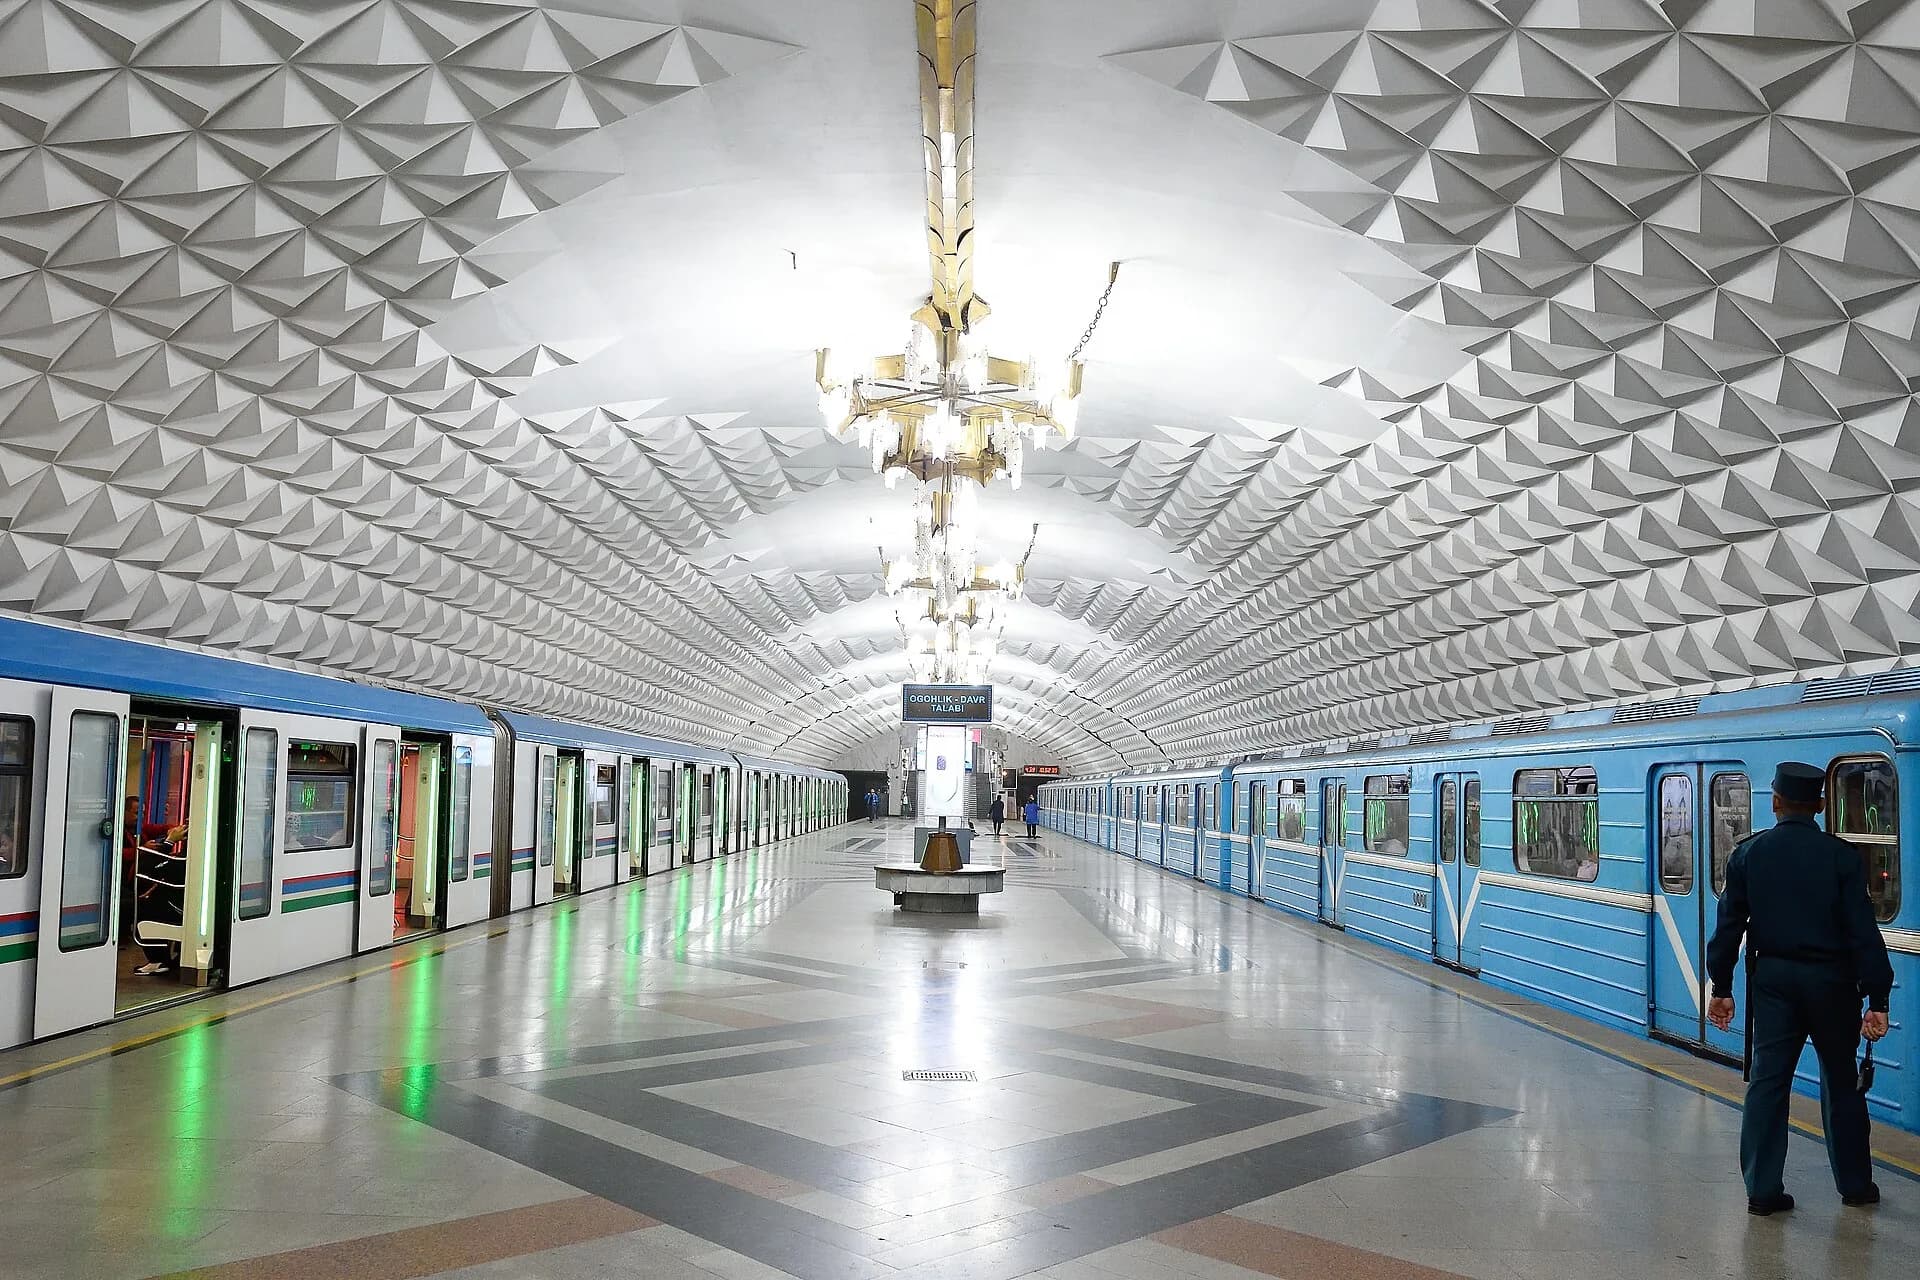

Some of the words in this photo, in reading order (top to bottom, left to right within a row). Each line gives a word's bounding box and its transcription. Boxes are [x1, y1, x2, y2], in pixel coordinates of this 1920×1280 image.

[909, 695, 953, 703] OGOHLIK
[960, 695, 986, 704] DAVR
[931, 704, 964, 712] TALABI
